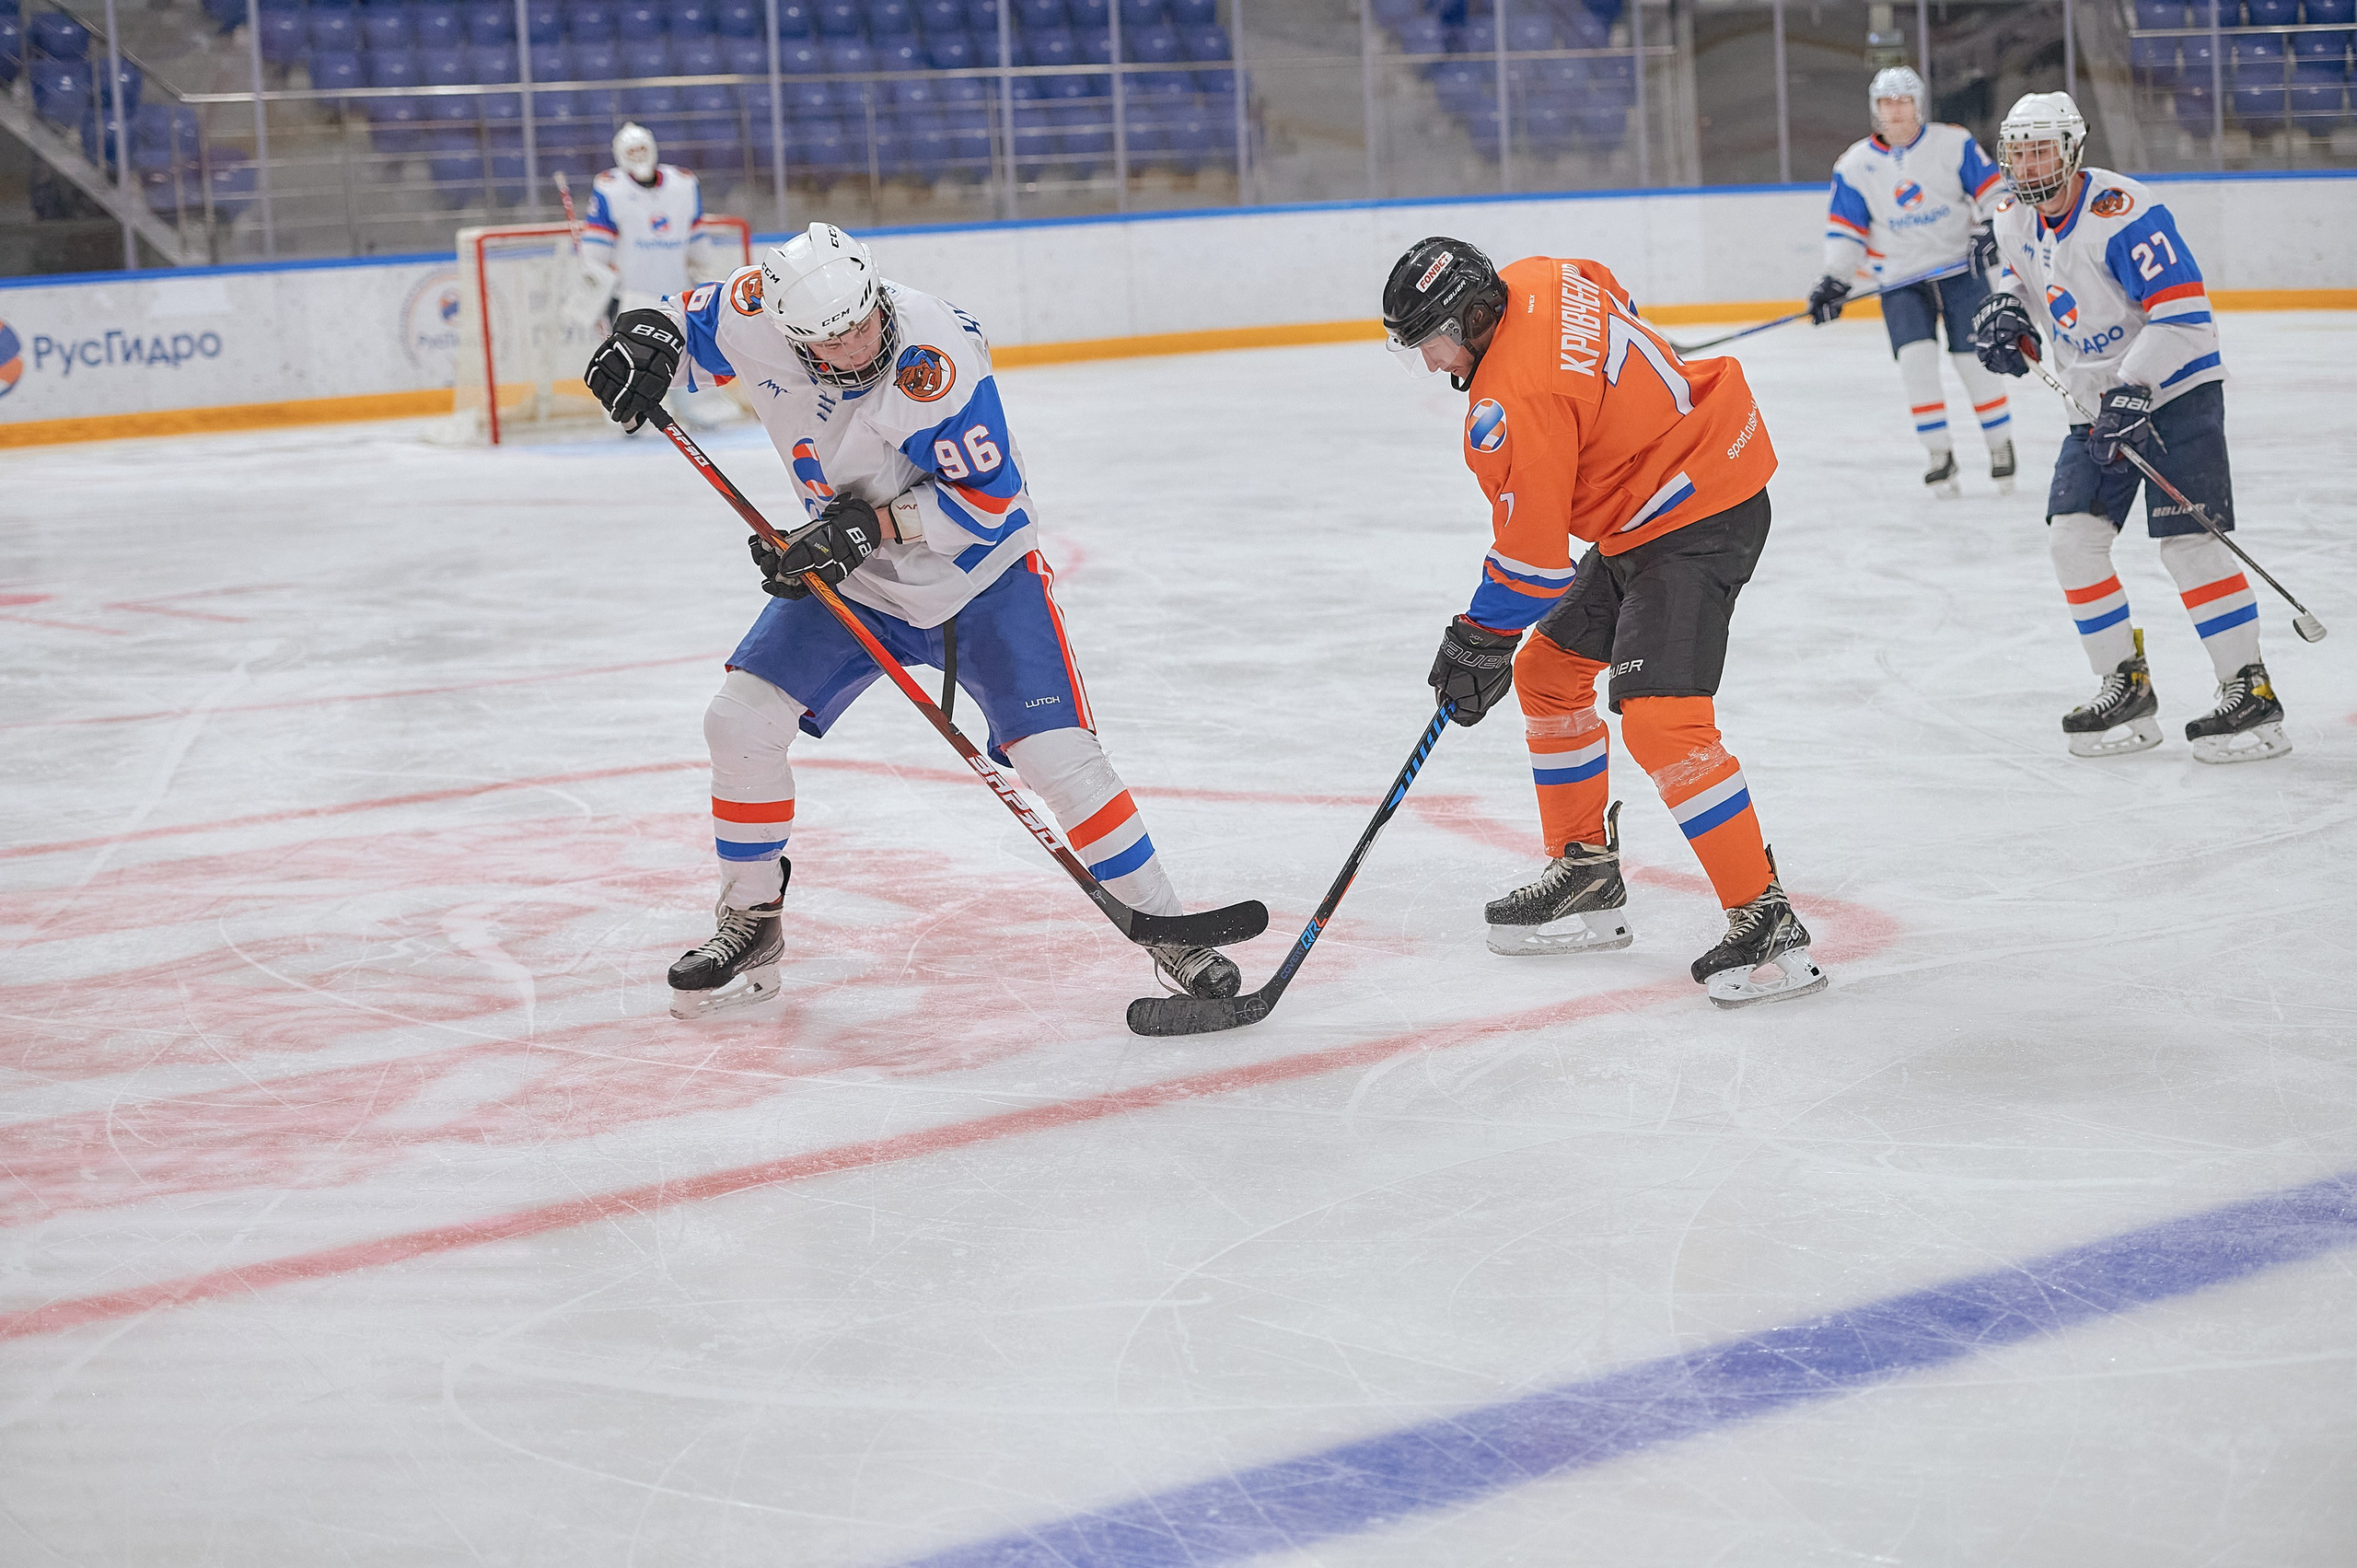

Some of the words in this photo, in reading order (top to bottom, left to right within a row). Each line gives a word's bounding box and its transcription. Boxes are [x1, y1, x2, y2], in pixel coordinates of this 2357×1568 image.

[761, 262, 781, 284] CCM
[1420, 253, 1450, 290] FONBET
[2131, 231, 2177, 281] 27
[821, 308, 851, 328] CCM
[33, 330, 222, 377] РусГидро
[666, 423, 711, 468] АРЯД
[934, 424, 1003, 480] 96
[1025, 695, 1061, 709] LUTCH
[1552, 894, 1573, 915] CCM
[1281, 944, 1306, 980] COVERT
[1300, 916, 1329, 950] QRL
